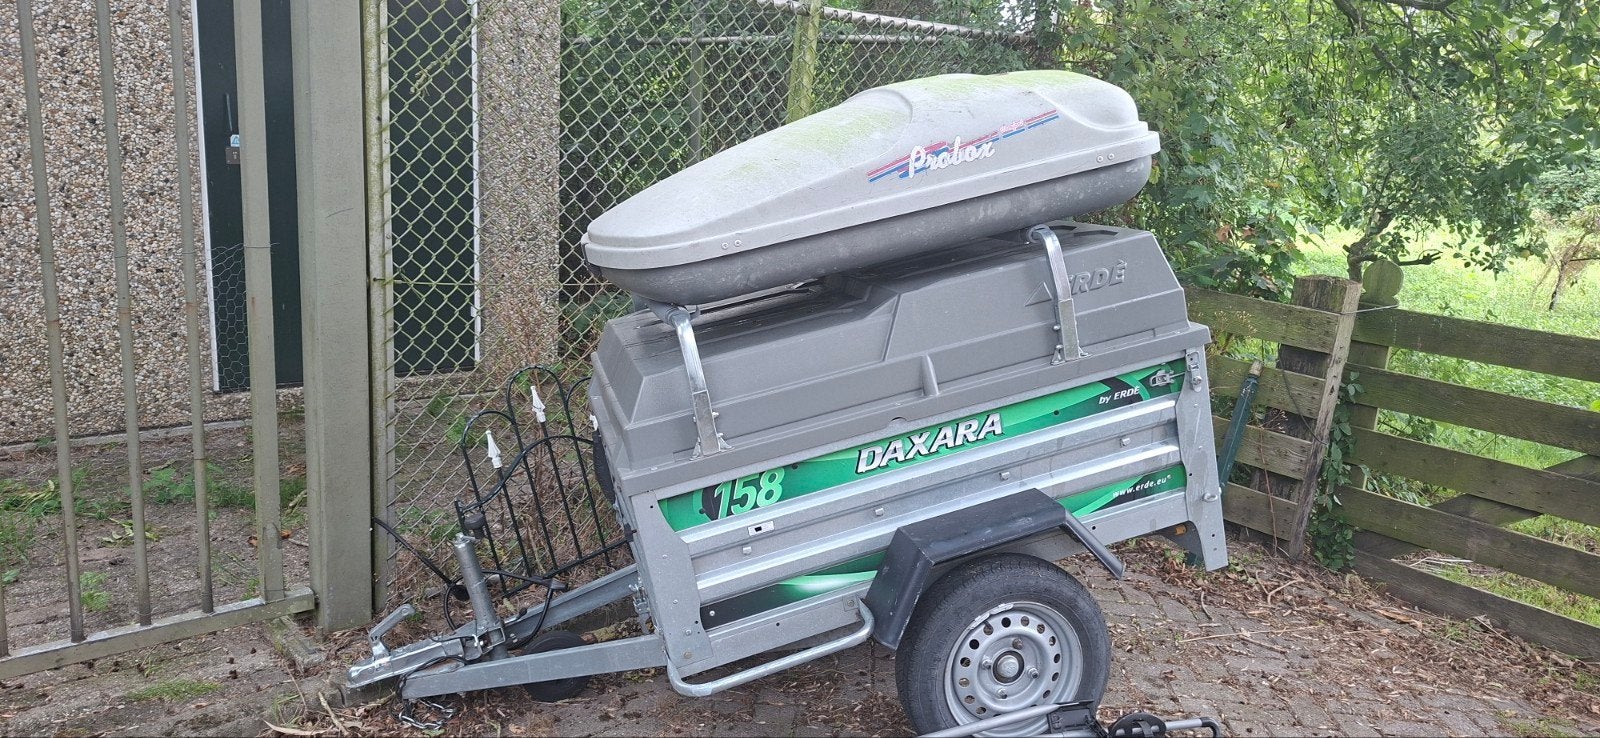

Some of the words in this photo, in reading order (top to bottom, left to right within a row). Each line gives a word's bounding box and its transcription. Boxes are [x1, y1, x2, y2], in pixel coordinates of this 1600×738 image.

[909, 136, 996, 178] Probox
[1098, 396, 1111, 404] by
[855, 412, 1003, 474] DAXARA
[713, 467, 786, 520] 158
